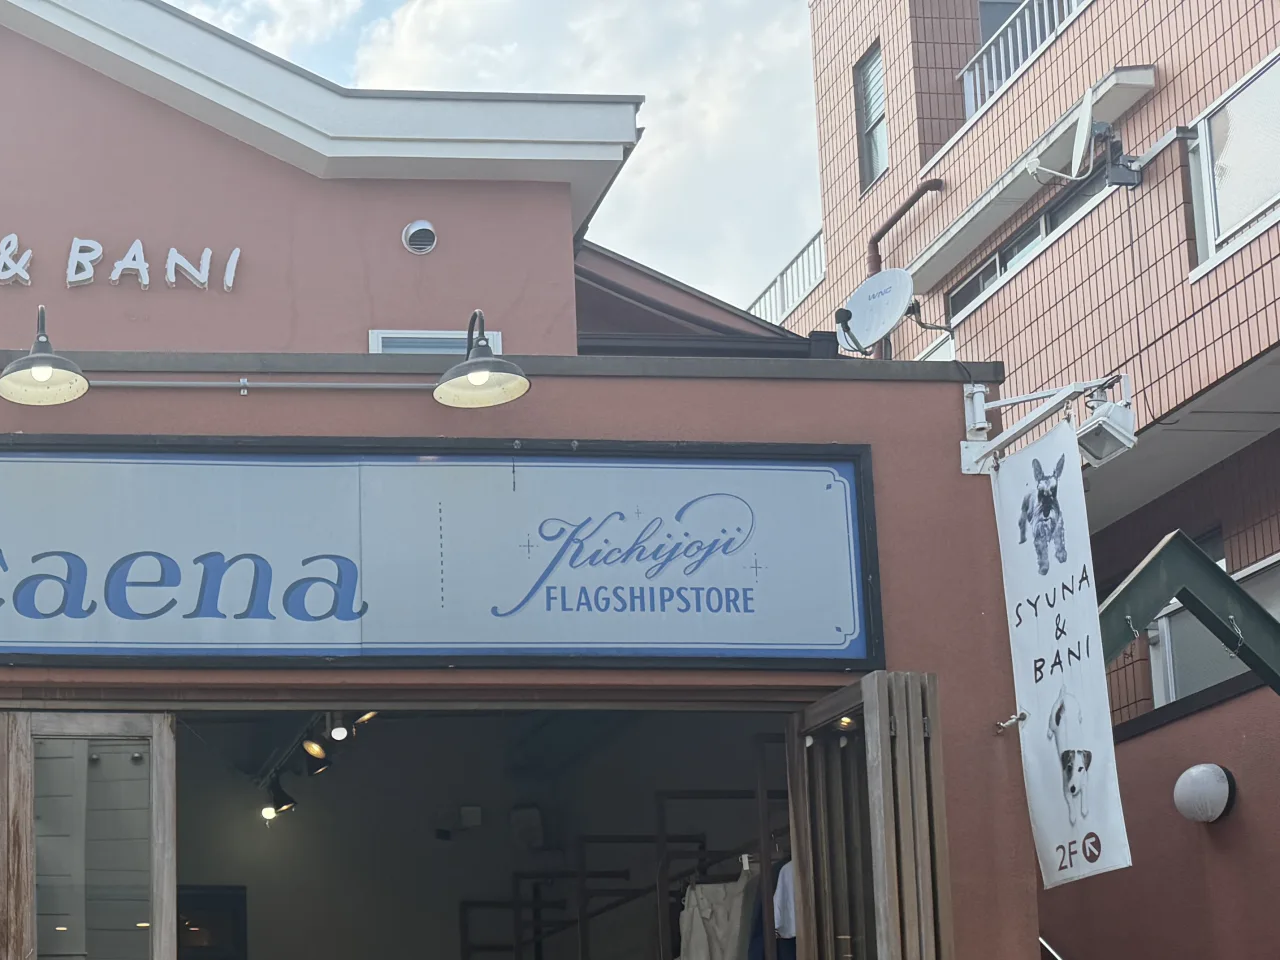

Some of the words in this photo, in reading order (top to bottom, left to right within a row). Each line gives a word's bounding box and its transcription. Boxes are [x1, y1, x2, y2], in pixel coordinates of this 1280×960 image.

[68, 237, 241, 291] BANI
[545, 585, 755, 613] FLAGSHIPSTORE
[1015, 564, 1091, 628] SYUNA
[1055, 613, 1067, 640] &
[1033, 635, 1090, 684] BANI
[1056, 841, 1078, 872] 2F
